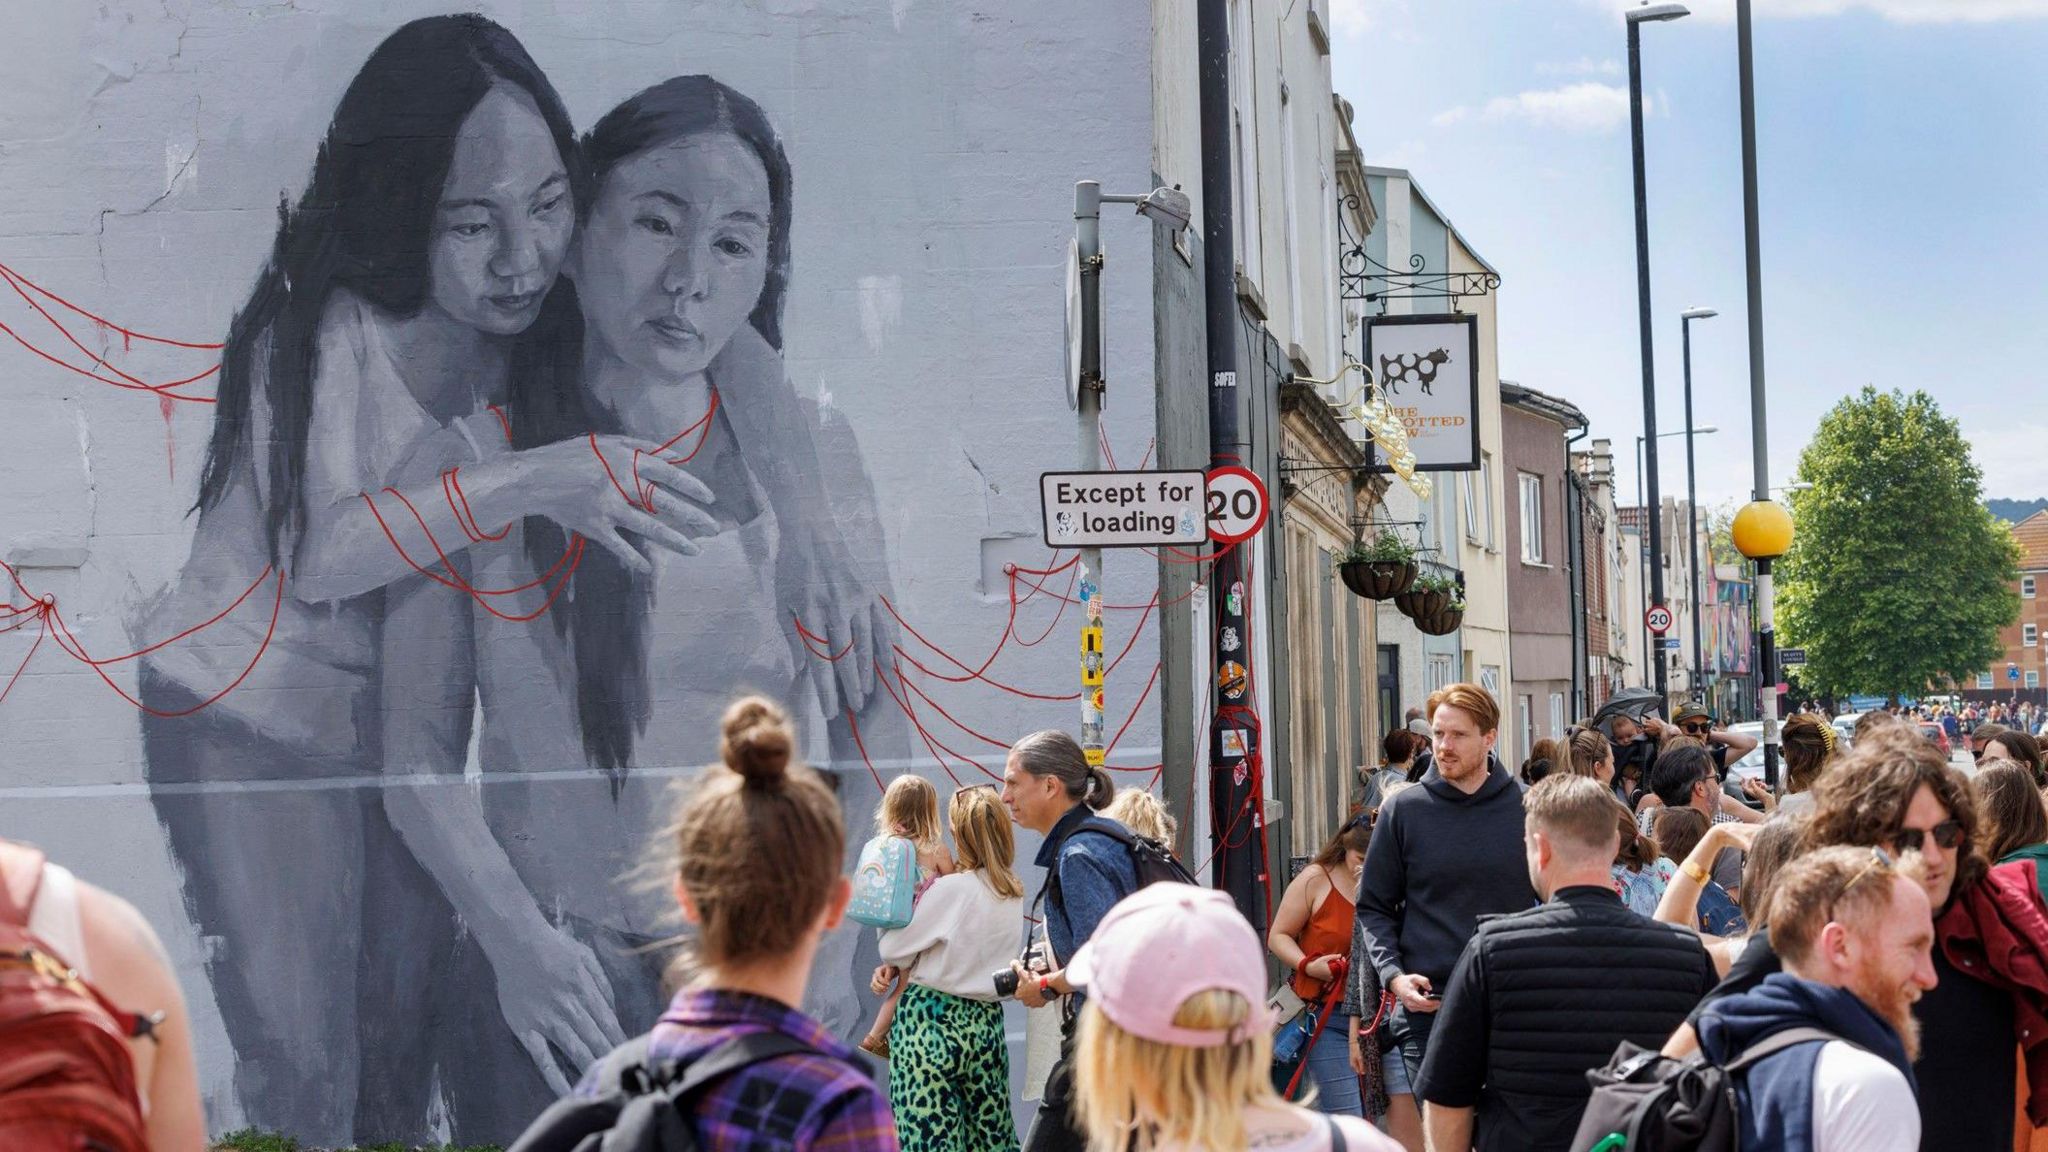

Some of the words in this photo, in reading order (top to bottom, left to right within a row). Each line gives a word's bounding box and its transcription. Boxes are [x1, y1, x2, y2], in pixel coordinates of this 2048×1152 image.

[1057, 482, 1146, 507] Except
[1158, 481, 1194, 503] for
[1207, 489, 1258, 521] 20
[1082, 511, 1176, 536] loading
[1650, 613, 1669, 626] 20
